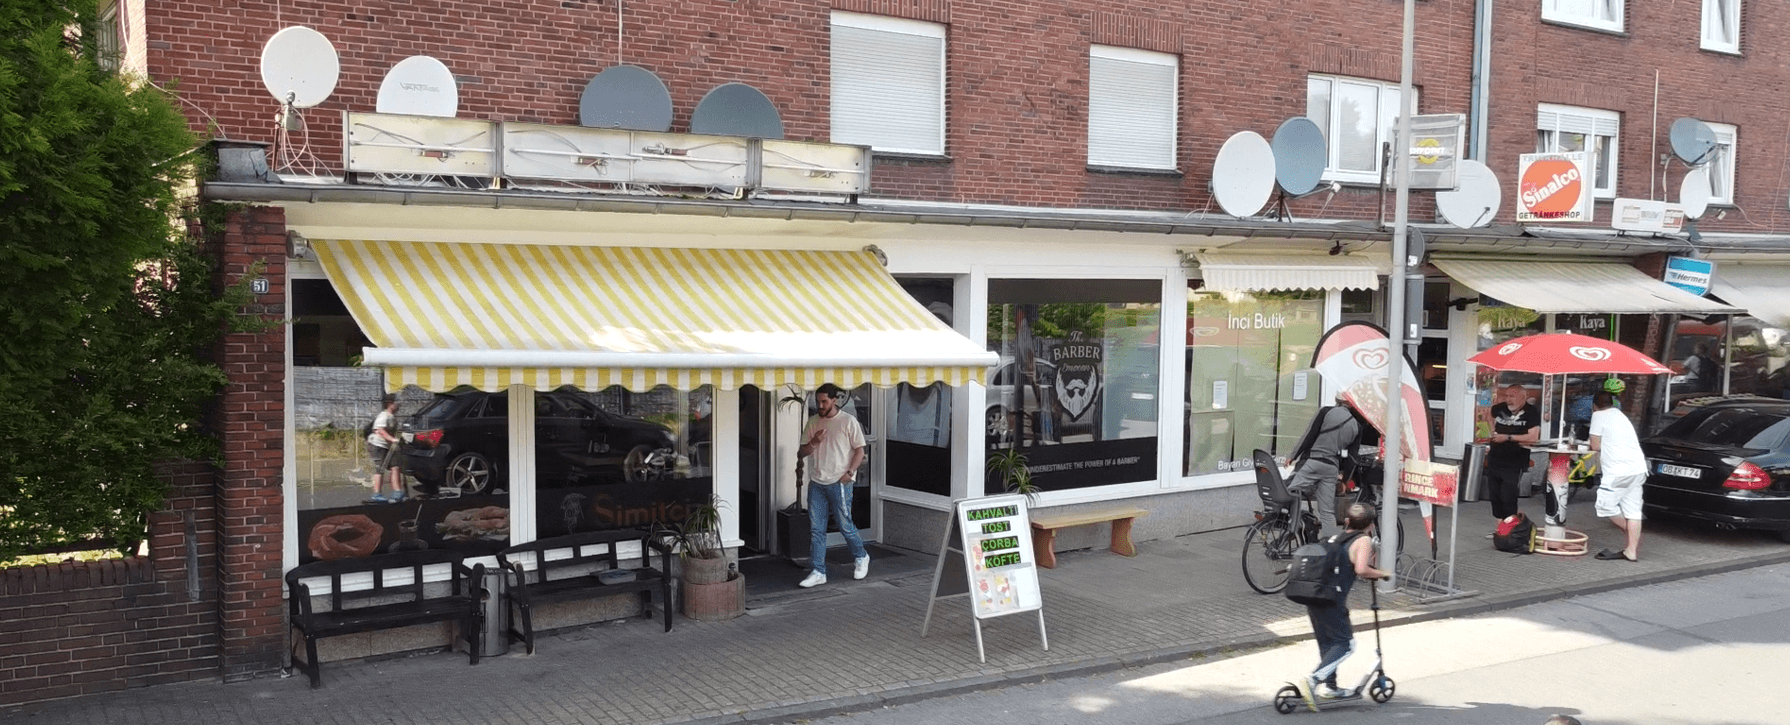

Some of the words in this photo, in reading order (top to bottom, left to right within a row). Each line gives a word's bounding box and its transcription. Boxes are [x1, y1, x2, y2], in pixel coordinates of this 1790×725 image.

[1522, 168, 1579, 208] Sinalco
[1677, 272, 1708, 285] Hermes
[253, 280, 266, 292] 51
[1254, 312, 1285, 329] Butik
[1579, 314, 1606, 331] Kaya
[1068, 330, 1085, 342] The
[1053, 345, 1100, 361] BARBER
[1073, 461, 1084, 469] THE
[1084, 459, 1104, 468] POWER
[1104, 459, 1111, 467] OF
[1218, 459, 1241, 472] Bayan
[1662, 464, 1674, 474] OB
[1690, 468, 1700, 477] 74
[967, 506, 1018, 520] KAHVALTI
[983, 522, 1009, 532] TOST
[982, 539, 1018, 552] ÇORBA
[986, 554, 1019, 568] KÖFTE
